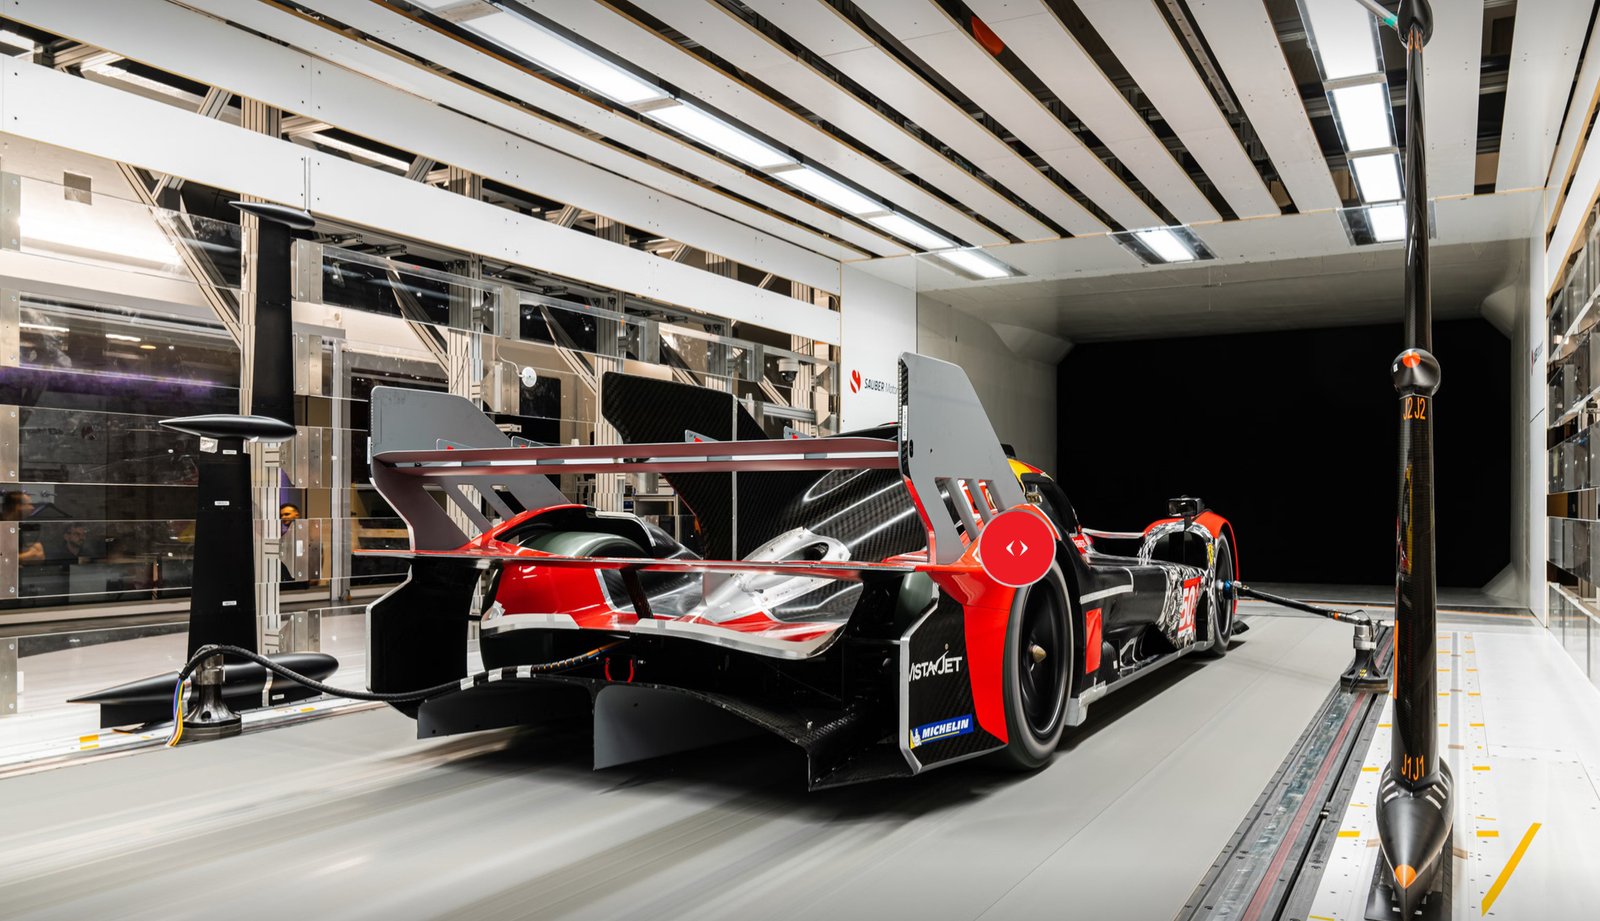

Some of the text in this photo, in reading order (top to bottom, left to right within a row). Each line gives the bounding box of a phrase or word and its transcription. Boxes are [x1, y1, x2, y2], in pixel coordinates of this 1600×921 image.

[864, 378, 884, 391] SAUBER
[1403, 397, 1426, 420] J2 J2
[922, 718, 969, 739] MICHELIN
[1401, 753, 1425, 781] J1 J1
